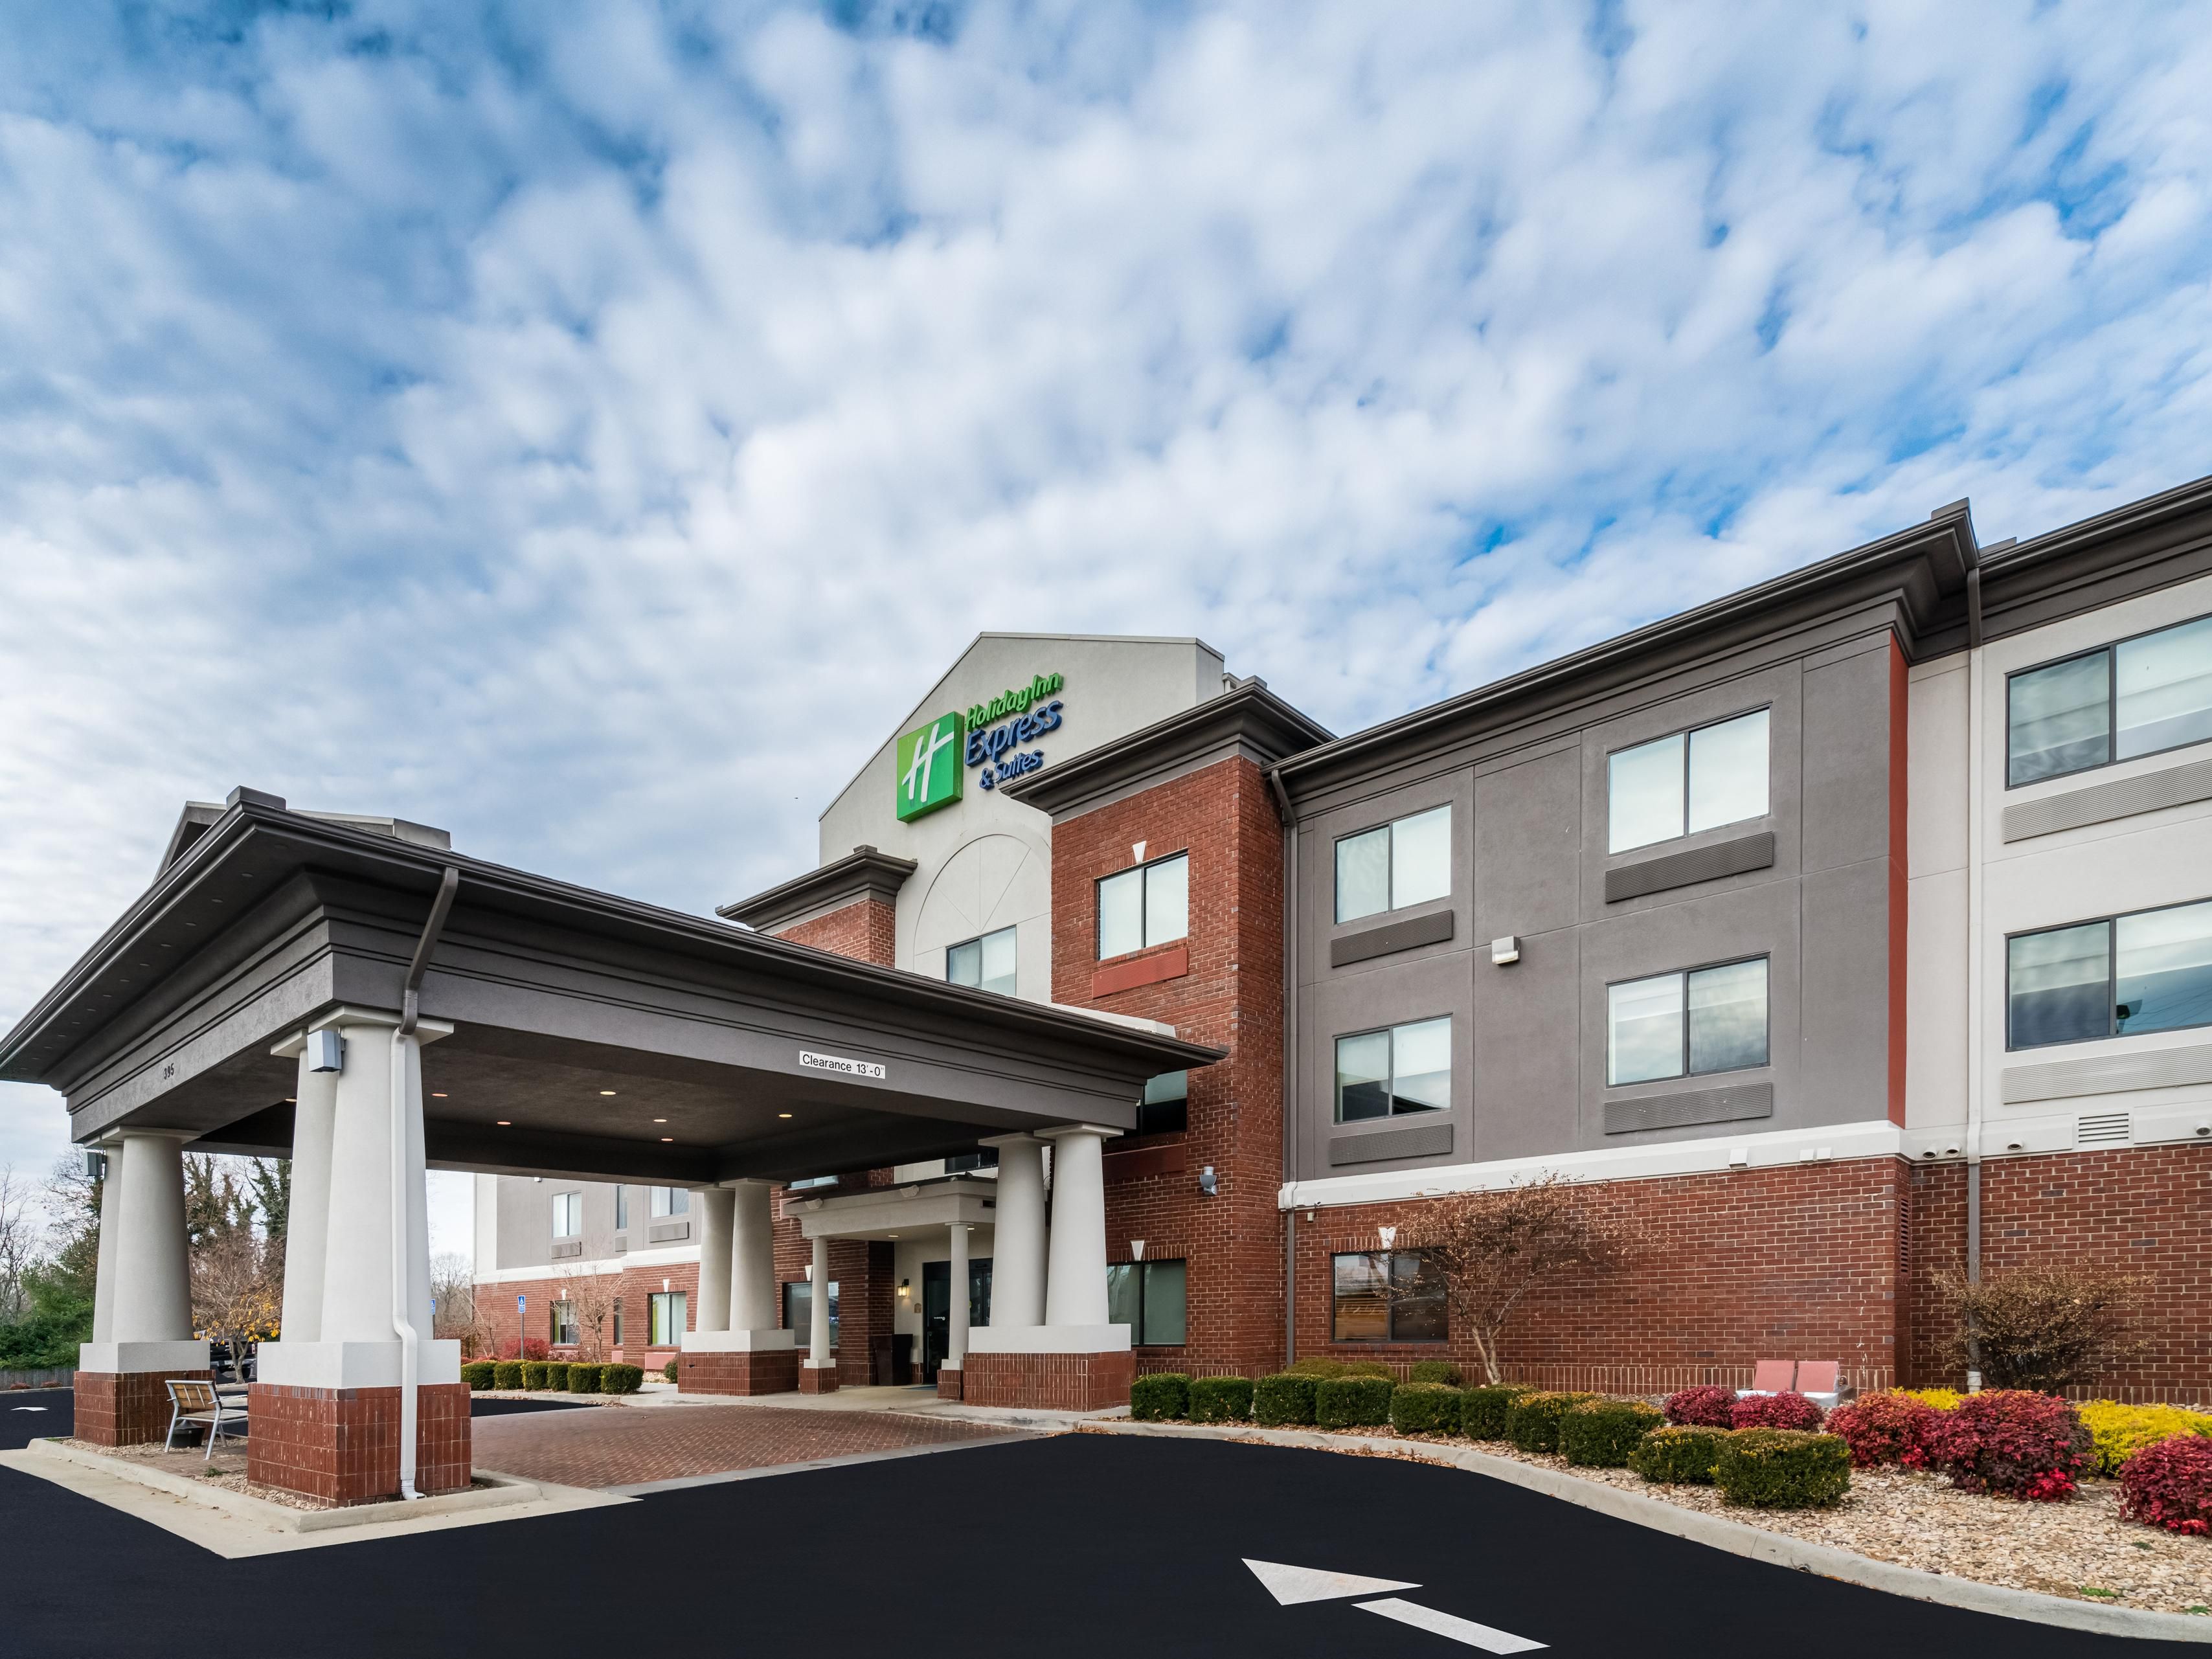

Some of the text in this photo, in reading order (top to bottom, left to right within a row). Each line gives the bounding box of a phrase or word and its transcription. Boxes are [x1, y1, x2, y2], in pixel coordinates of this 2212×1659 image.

[965, 672, 1063, 732] Holiday Inn
[965, 700, 1063, 767] Express
[979, 749, 1044, 789] & Suites
[164, 1063, 174, 1080] 395
[802, 1054, 852, 1072] Clearance
